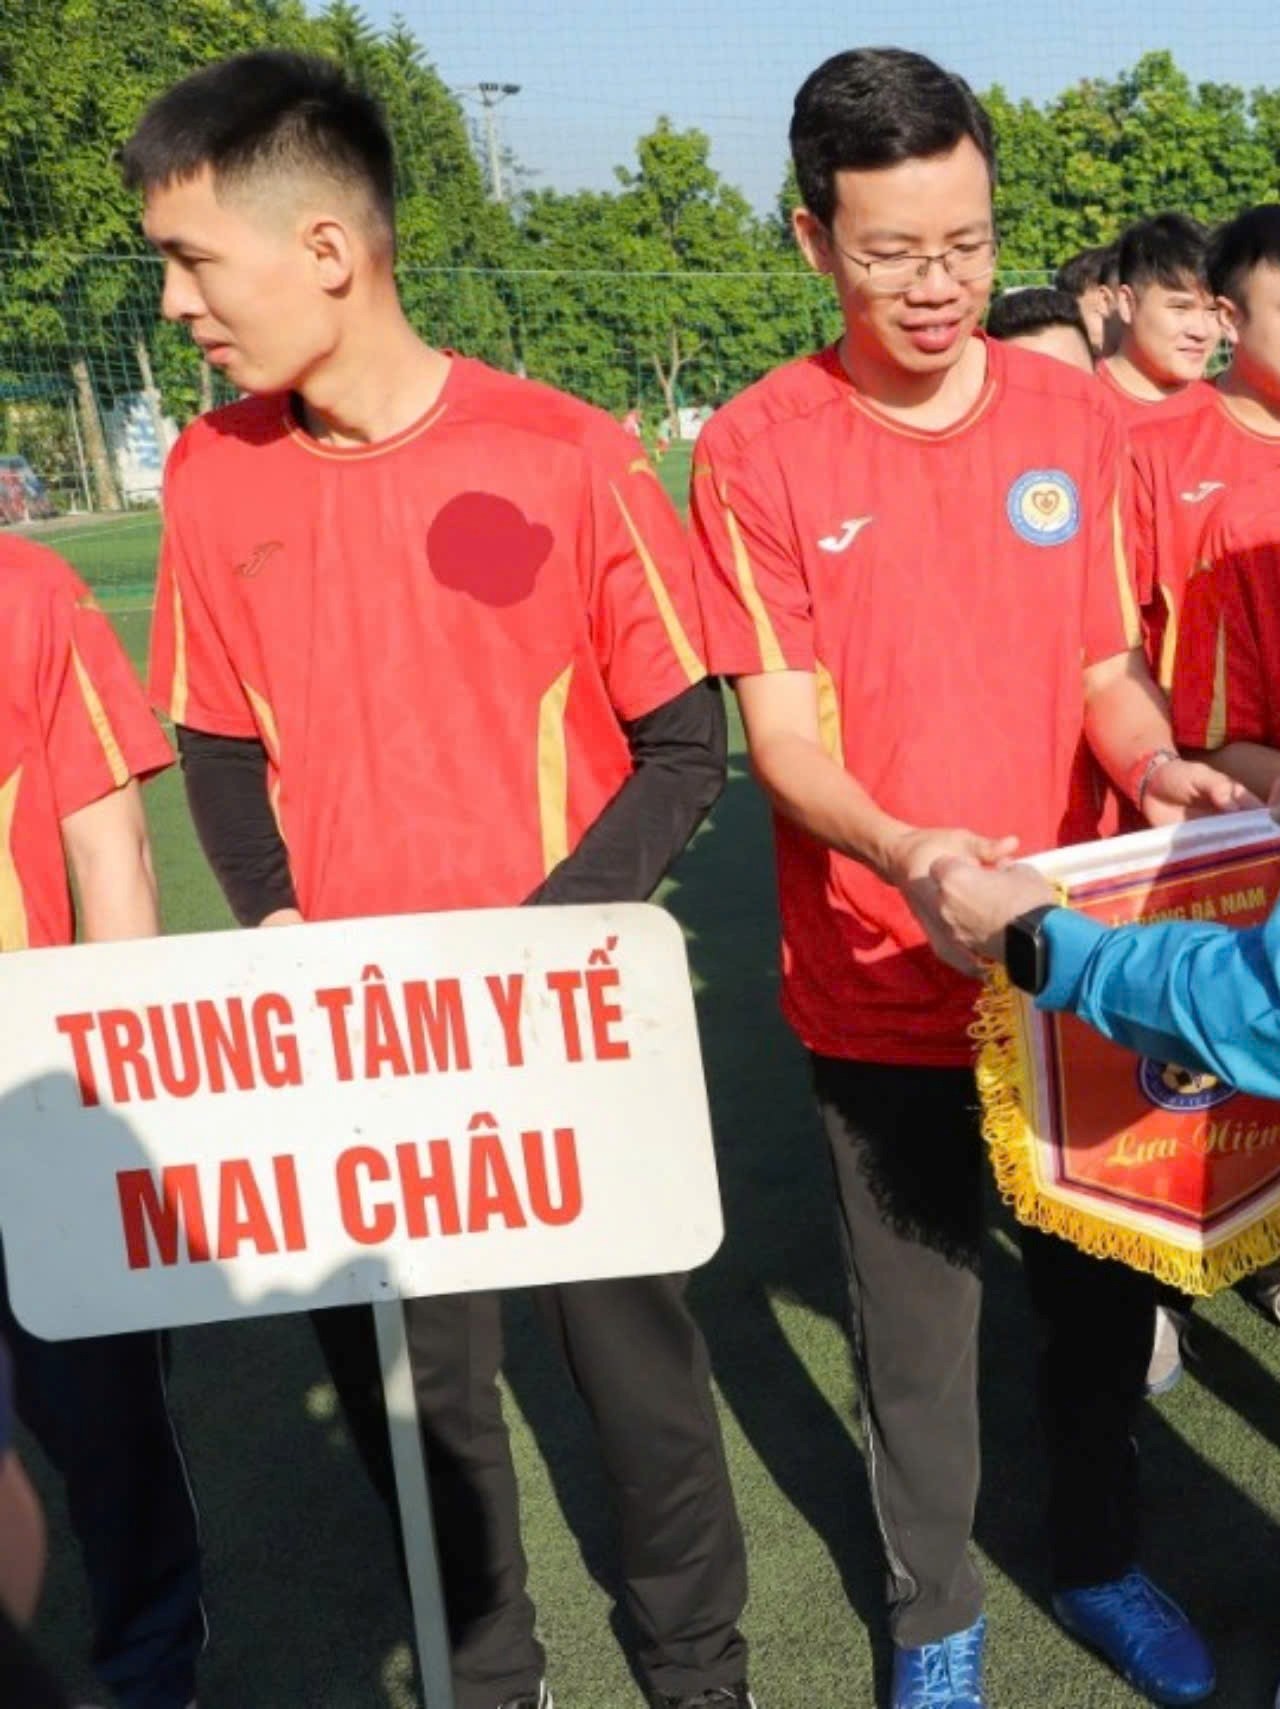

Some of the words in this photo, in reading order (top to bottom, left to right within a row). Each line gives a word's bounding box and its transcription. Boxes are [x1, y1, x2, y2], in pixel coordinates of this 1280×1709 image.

[1220, 886, 1267, 915] NAM
[55, 991, 303, 1107] TRUNG
[315, 963, 472, 1083] TÂM
[485, 973, 525, 1068] Y
[545, 934, 631, 1063] TẾ
[116, 1153, 307, 1270] MAI
[334, 1111, 584, 1246] CHÂU
